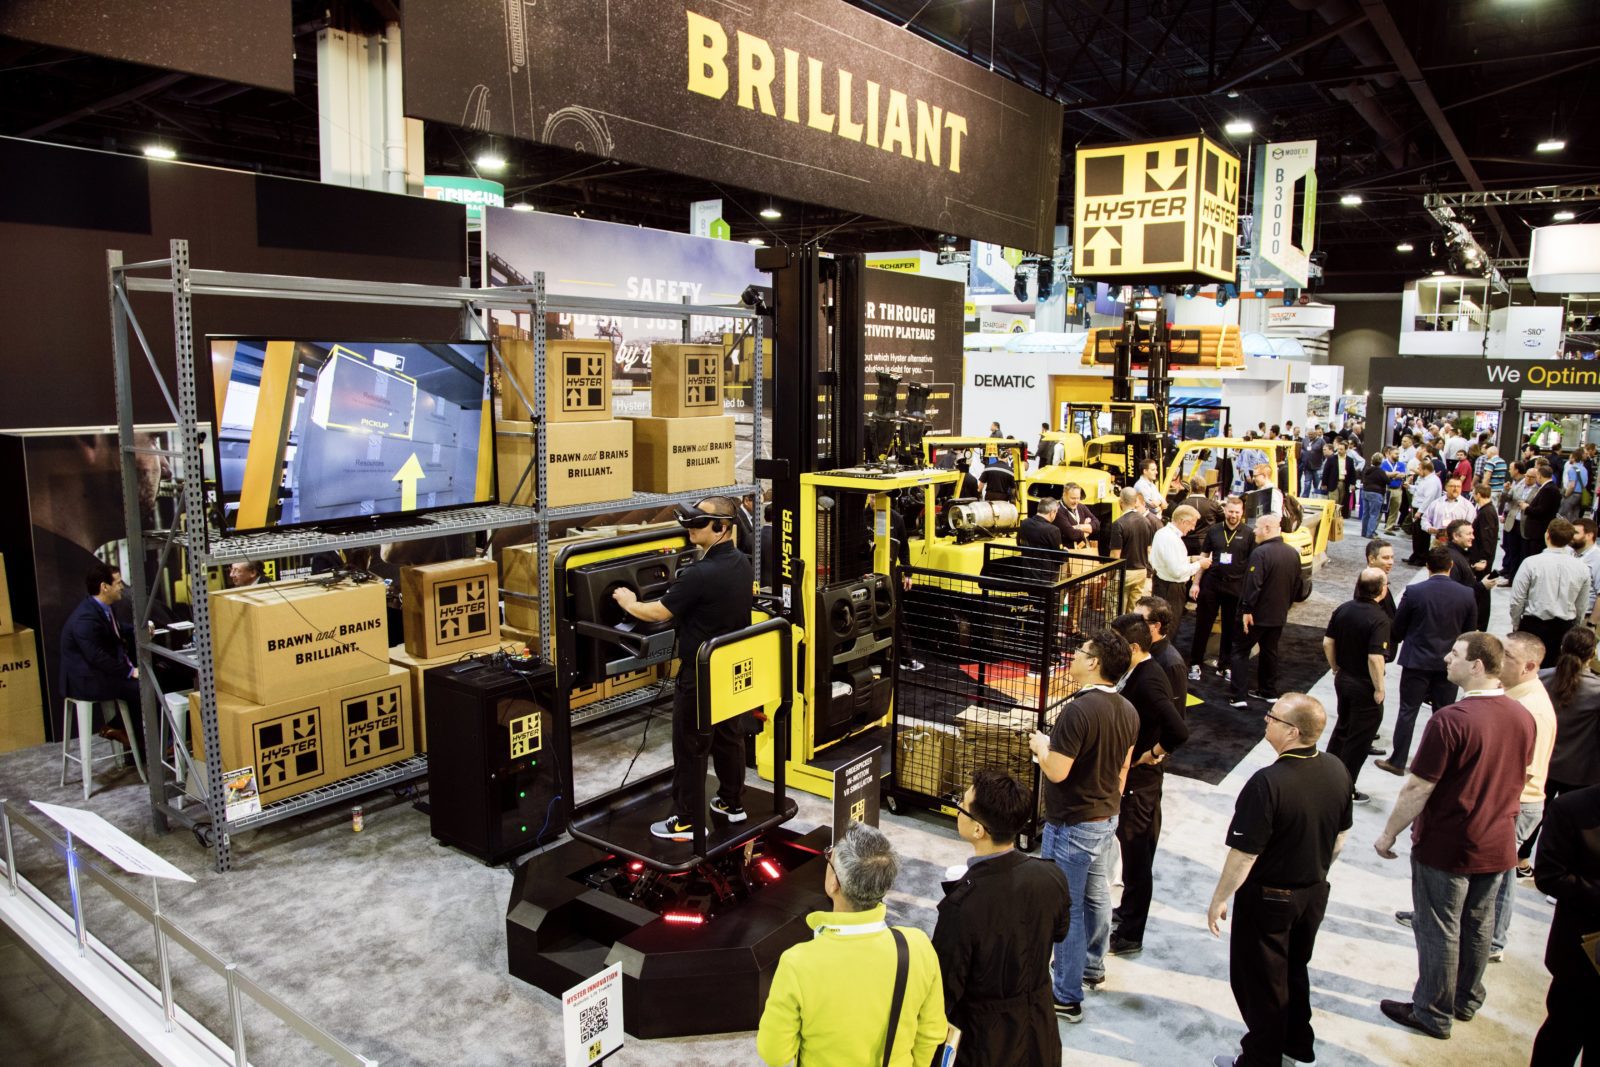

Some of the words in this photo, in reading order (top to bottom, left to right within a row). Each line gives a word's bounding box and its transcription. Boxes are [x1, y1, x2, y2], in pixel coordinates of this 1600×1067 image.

[686, 9, 968, 174] BRILLIANT
[1084, 196, 1187, 222] HYSTER
[1203, 197, 1235, 228] HYSTER
[1271, 168, 1284, 255] B3000
[626, 276, 703, 303] SAFETY
[879, 303, 936, 324] THROUGH
[896, 326, 936, 340] PLATEAUS
[615, 339, 639, 372] by
[874, 352, 890, 362] which
[890, 353, 907, 363] Hyster
[907, 354, 933, 363] alternative
[904, 365, 912, 374] for
[1486, 365, 1521, 384] We
[566, 377, 602, 387] HYSTER
[687, 376, 717, 386] HYSTER
[974, 374, 1036, 389] DEMATIC
[616, 400, 645, 412] Hyster
[737, 398, 745, 408] to
[361, 418, 389, 429] PICKUP
[549, 451, 581, 464] BRAWN
[582, 450, 597, 462] and
[599, 449, 629, 460] BRAINS
[672, 443, 697, 454] BRAWN
[697, 442, 709, 452] and
[709, 440, 732, 451] BRAINS
[686, 456, 720, 468] BRILLIANT.
[567, 467, 613, 479] BRILLIANT.
[781, 509, 793, 579] HYSTER
[440, 601, 486, 619] HYSTER
[267, 632, 313, 652] BRAWN
[315, 626, 340, 642] and
[339, 617, 382, 636] BRAINS
[295, 642, 360, 665] BRILLIANT.
[0, 659, 31, 673] AINS
[348, 714, 398, 737] HYSTER
[512, 728, 539, 742] HYSTER
[261, 737, 317, 763] HYSTER
[845, 756, 873, 777] ORDERPICKER
[843, 787, 850, 797] VR
[850, 775, 873, 794] SIMULATOR
[846, 767, 870, 786] IN-MOTION
[566, 988, 587, 1006] HYSTER
[587, 971, 618, 994] INNOVATION
